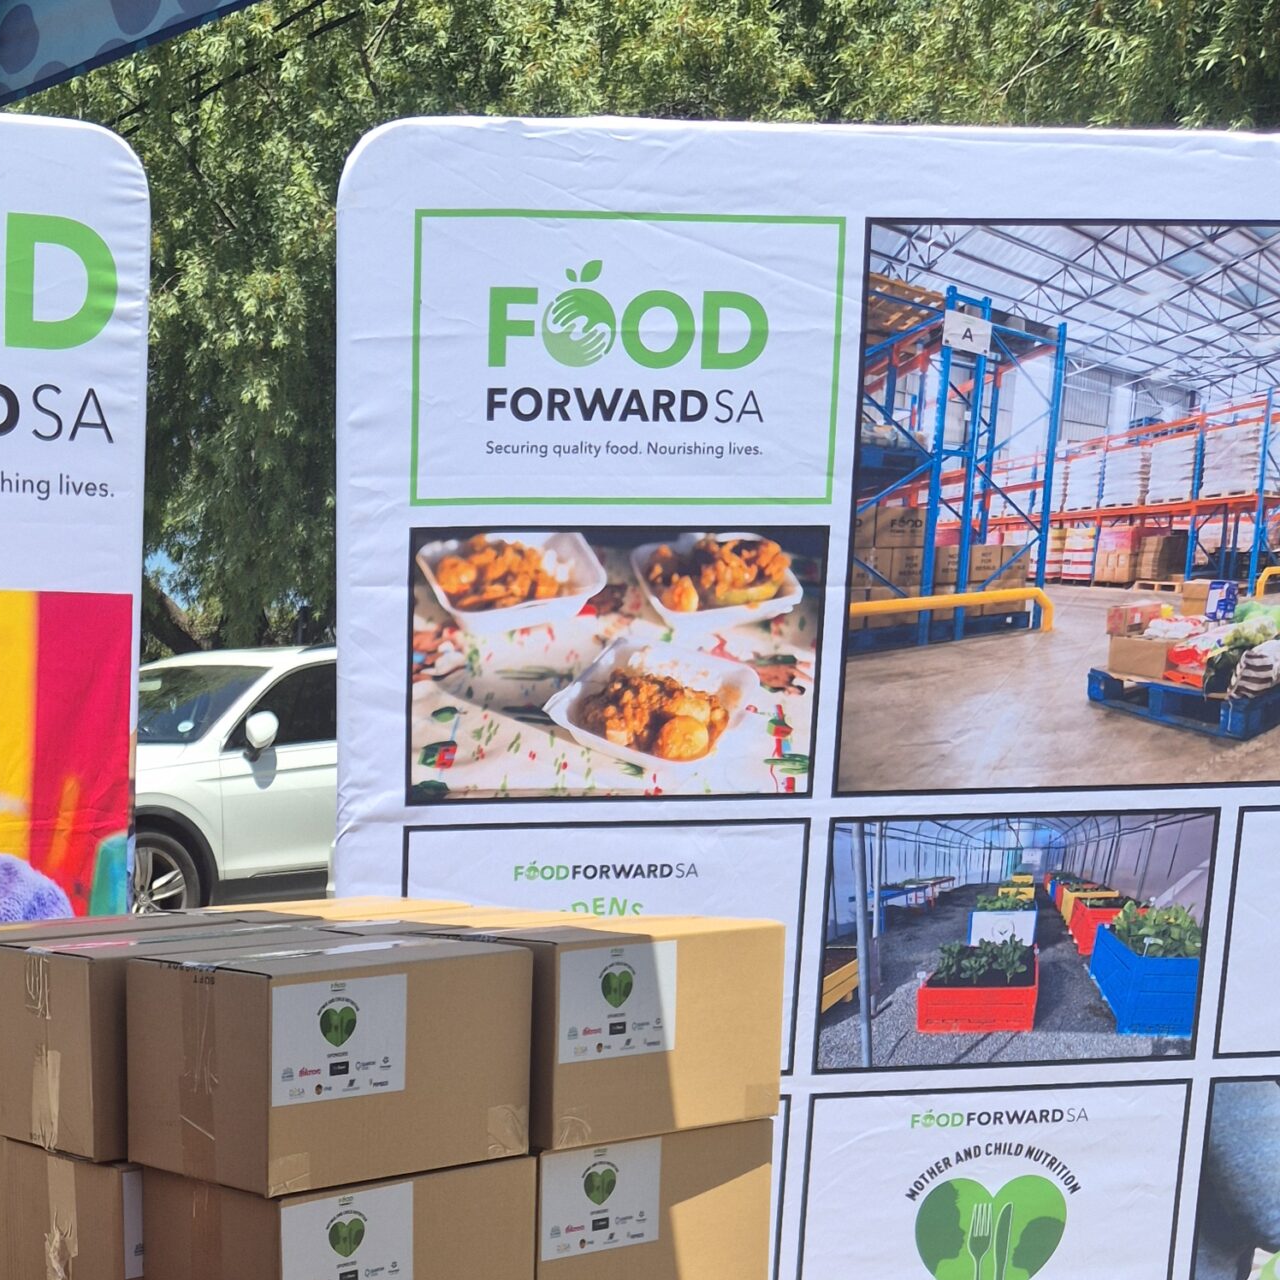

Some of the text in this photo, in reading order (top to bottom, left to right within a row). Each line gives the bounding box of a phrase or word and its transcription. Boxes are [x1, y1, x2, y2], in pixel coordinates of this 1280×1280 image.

[488, 284, 769, 369] FOOD
[962, 327, 973, 342] A
[486, 440, 763, 459] Securing quality food. Nourishing lives.
[59, 473, 115, 498] lives.
[560, 896, 644, 917] DENS
[905, 1142, 1082, 1202] MOTHER AND CHILD NUTRITION
